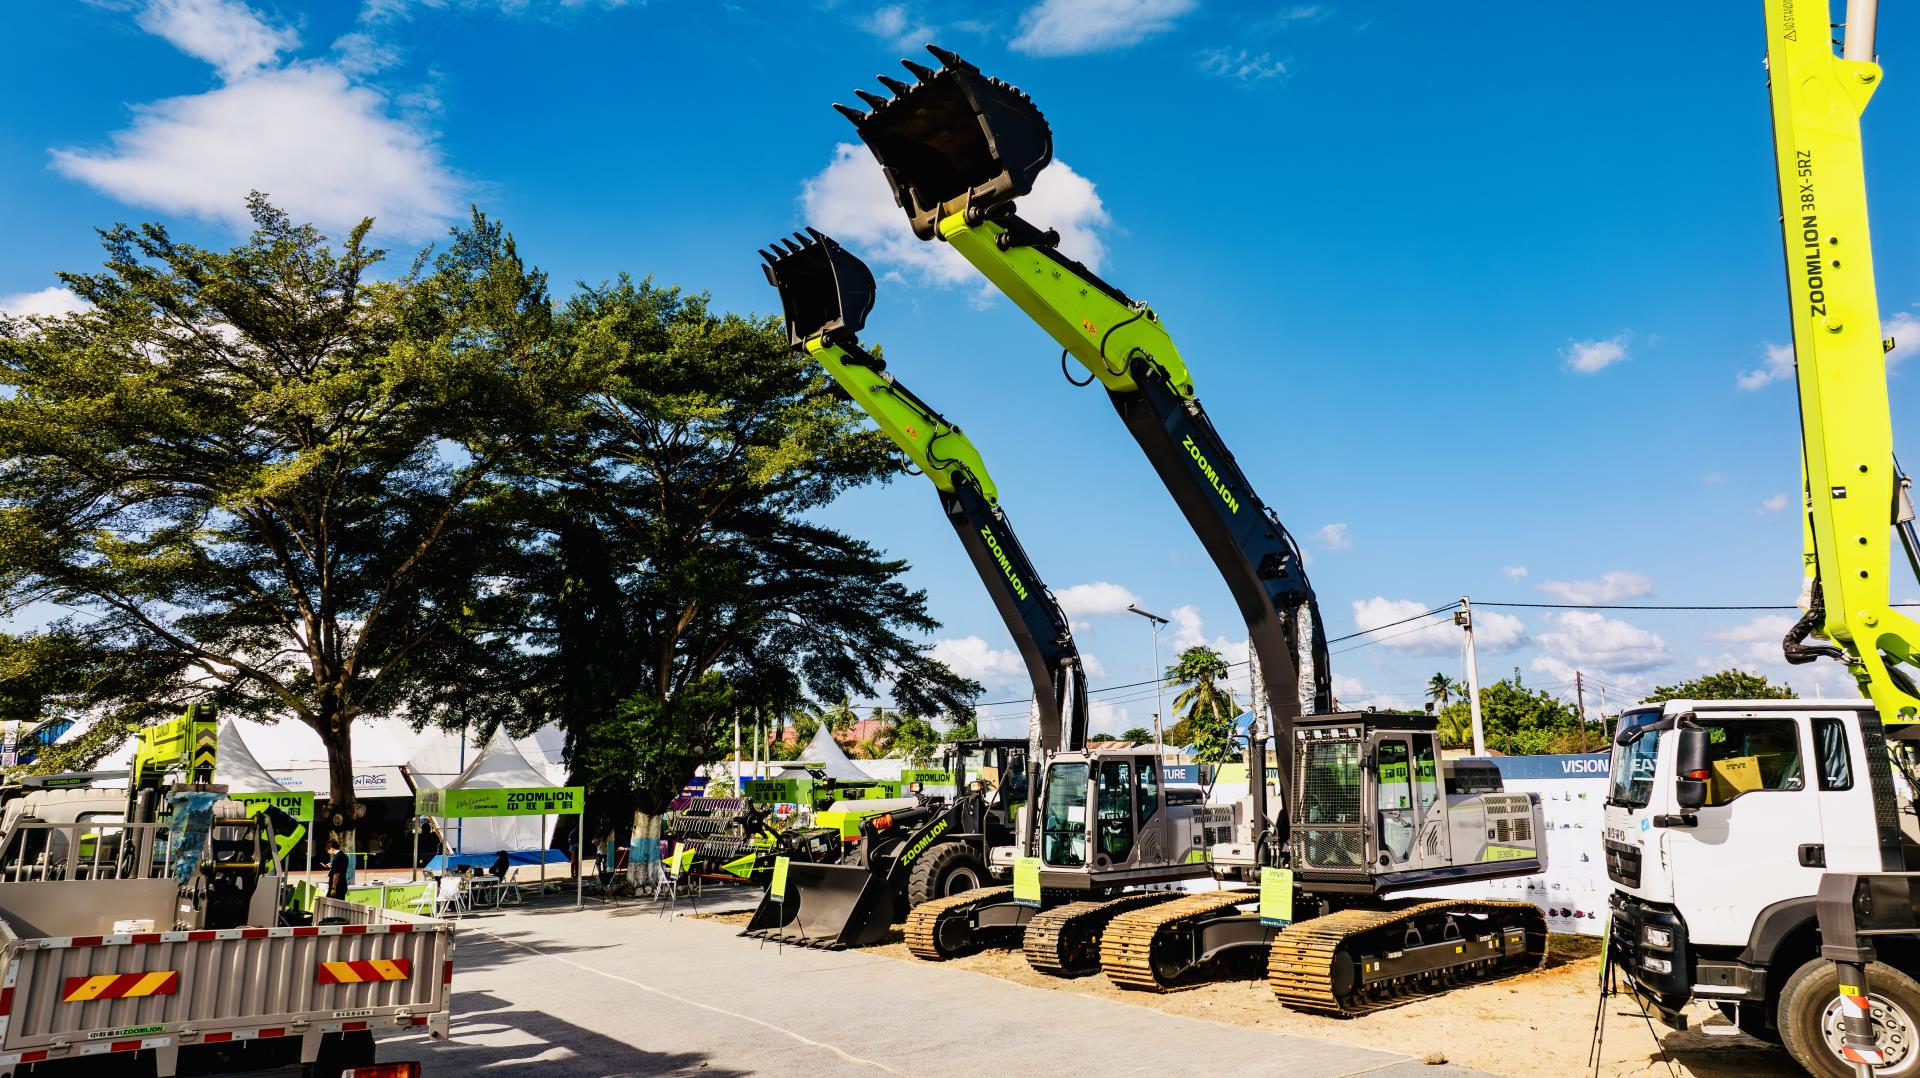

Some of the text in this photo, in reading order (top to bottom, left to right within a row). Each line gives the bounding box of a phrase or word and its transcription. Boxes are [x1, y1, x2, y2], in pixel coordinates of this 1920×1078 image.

[1797, 150, 1826, 317] ZOOMLION 38X-5RZ
[1182, 435, 1239, 514] ZOOMLION
[981, 525, 1028, 601] ZOOMLION
[1562, 759, 1609, 773] VISION
[915, 773, 950, 783] ZOOMLION
[1163, 769, 1186, 779] TURE
[755, 783, 786, 792] ZOOMLION
[507, 792, 574, 802] ZOOMLION
[901, 819, 948, 866] ZOOMLION
[123, 1026, 163, 1035] ZOOMLION
